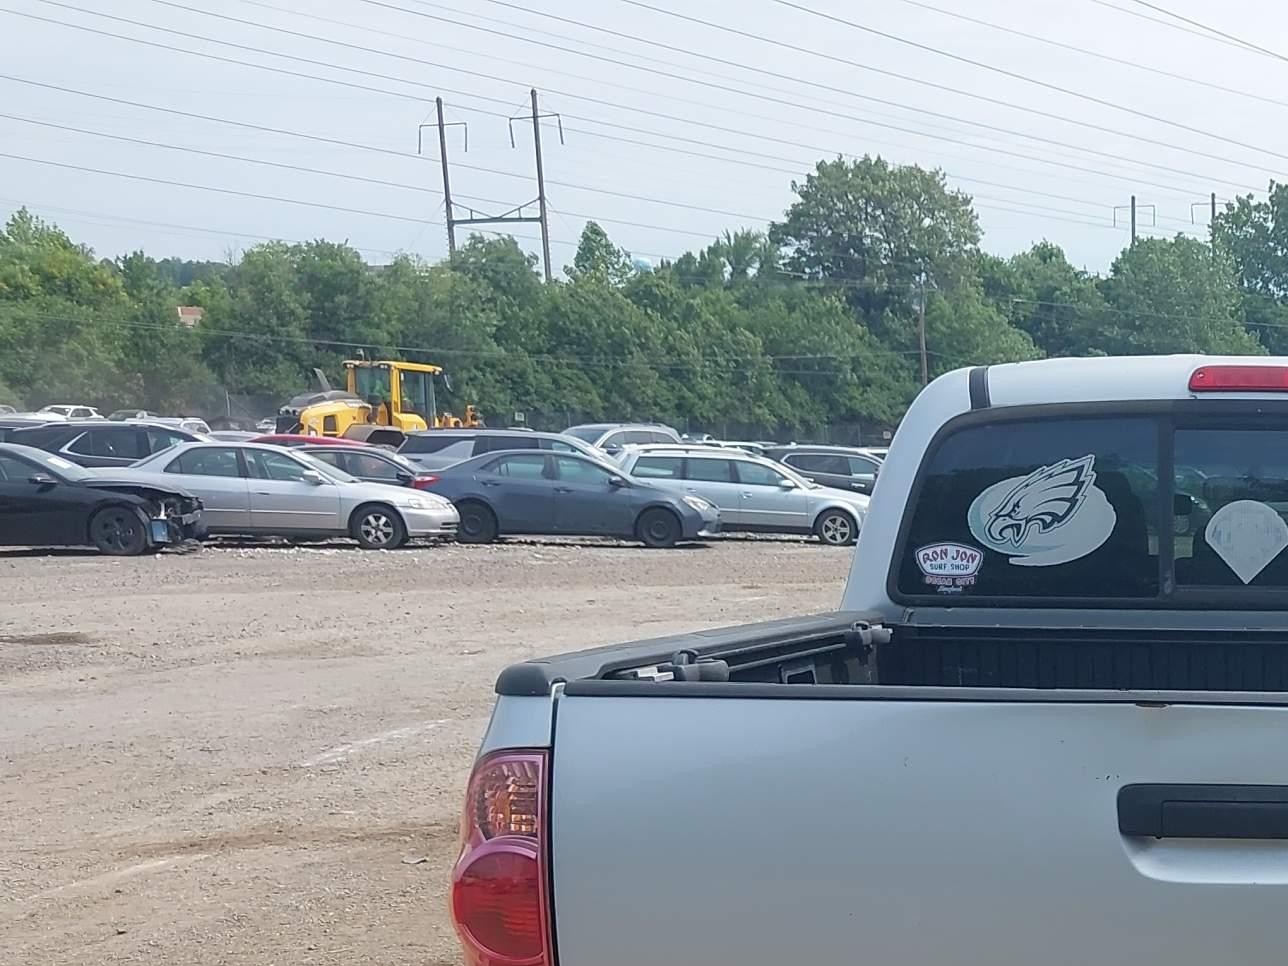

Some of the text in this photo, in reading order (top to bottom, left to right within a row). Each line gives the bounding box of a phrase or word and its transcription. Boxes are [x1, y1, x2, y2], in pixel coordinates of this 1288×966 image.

[922, 548, 978, 564] RON JON
[929, 563, 970, 571] SURF SHOP
